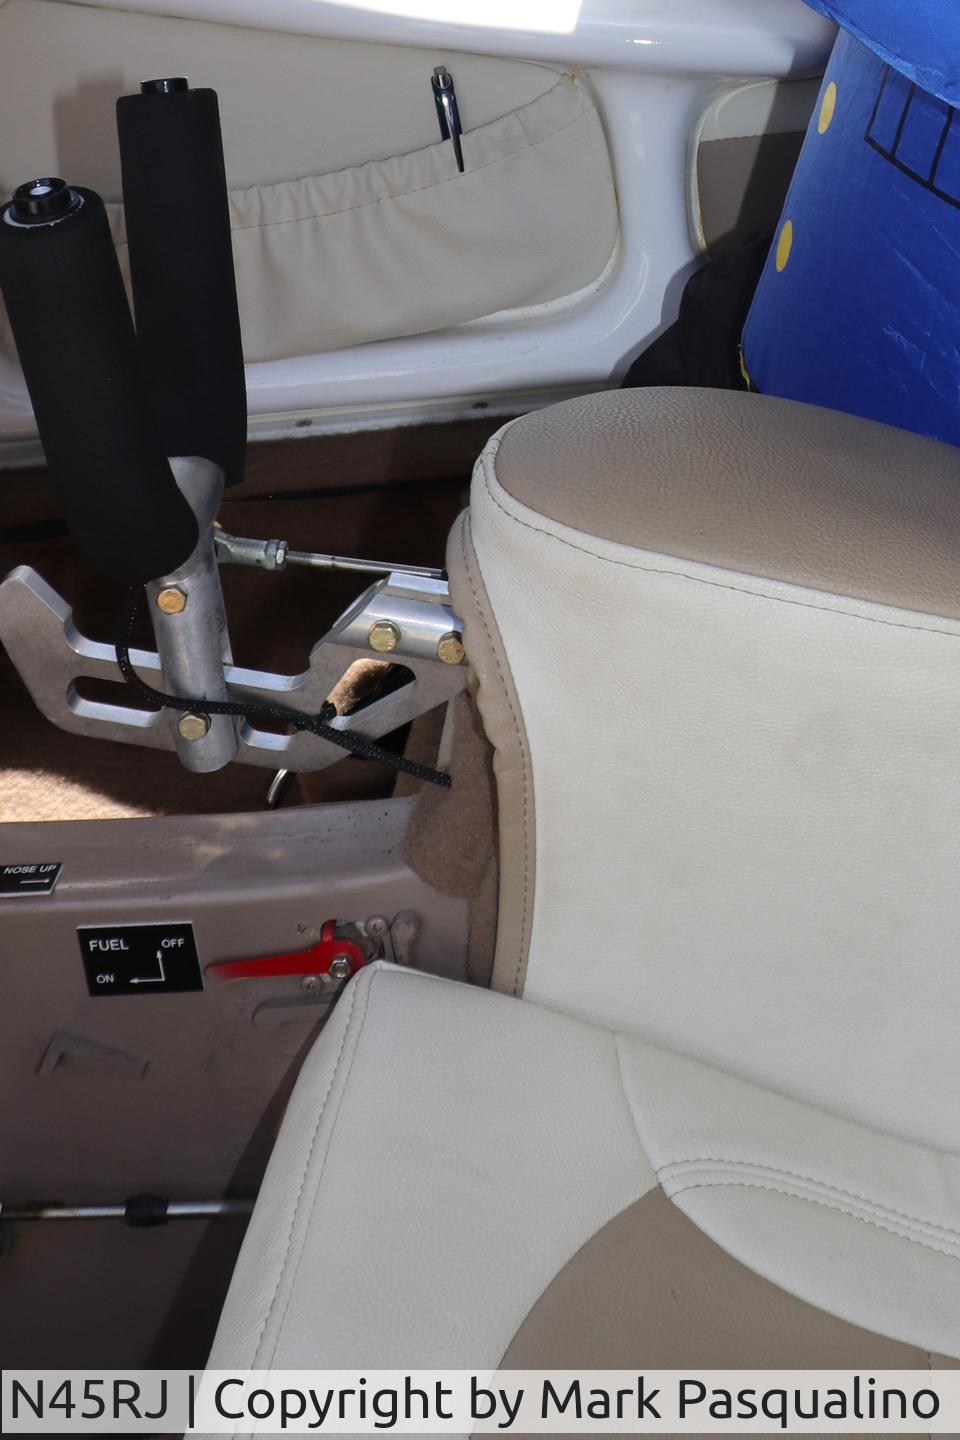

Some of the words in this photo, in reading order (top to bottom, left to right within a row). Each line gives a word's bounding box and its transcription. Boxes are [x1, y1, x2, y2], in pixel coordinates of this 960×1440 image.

[3, 865, 36, 875] NOSE
[40, 864, 57, 873] UP
[88, 939, 129, 952] FUEL
[161, 938, 185, 948] OFF
[96, 973, 115, 984] ON
